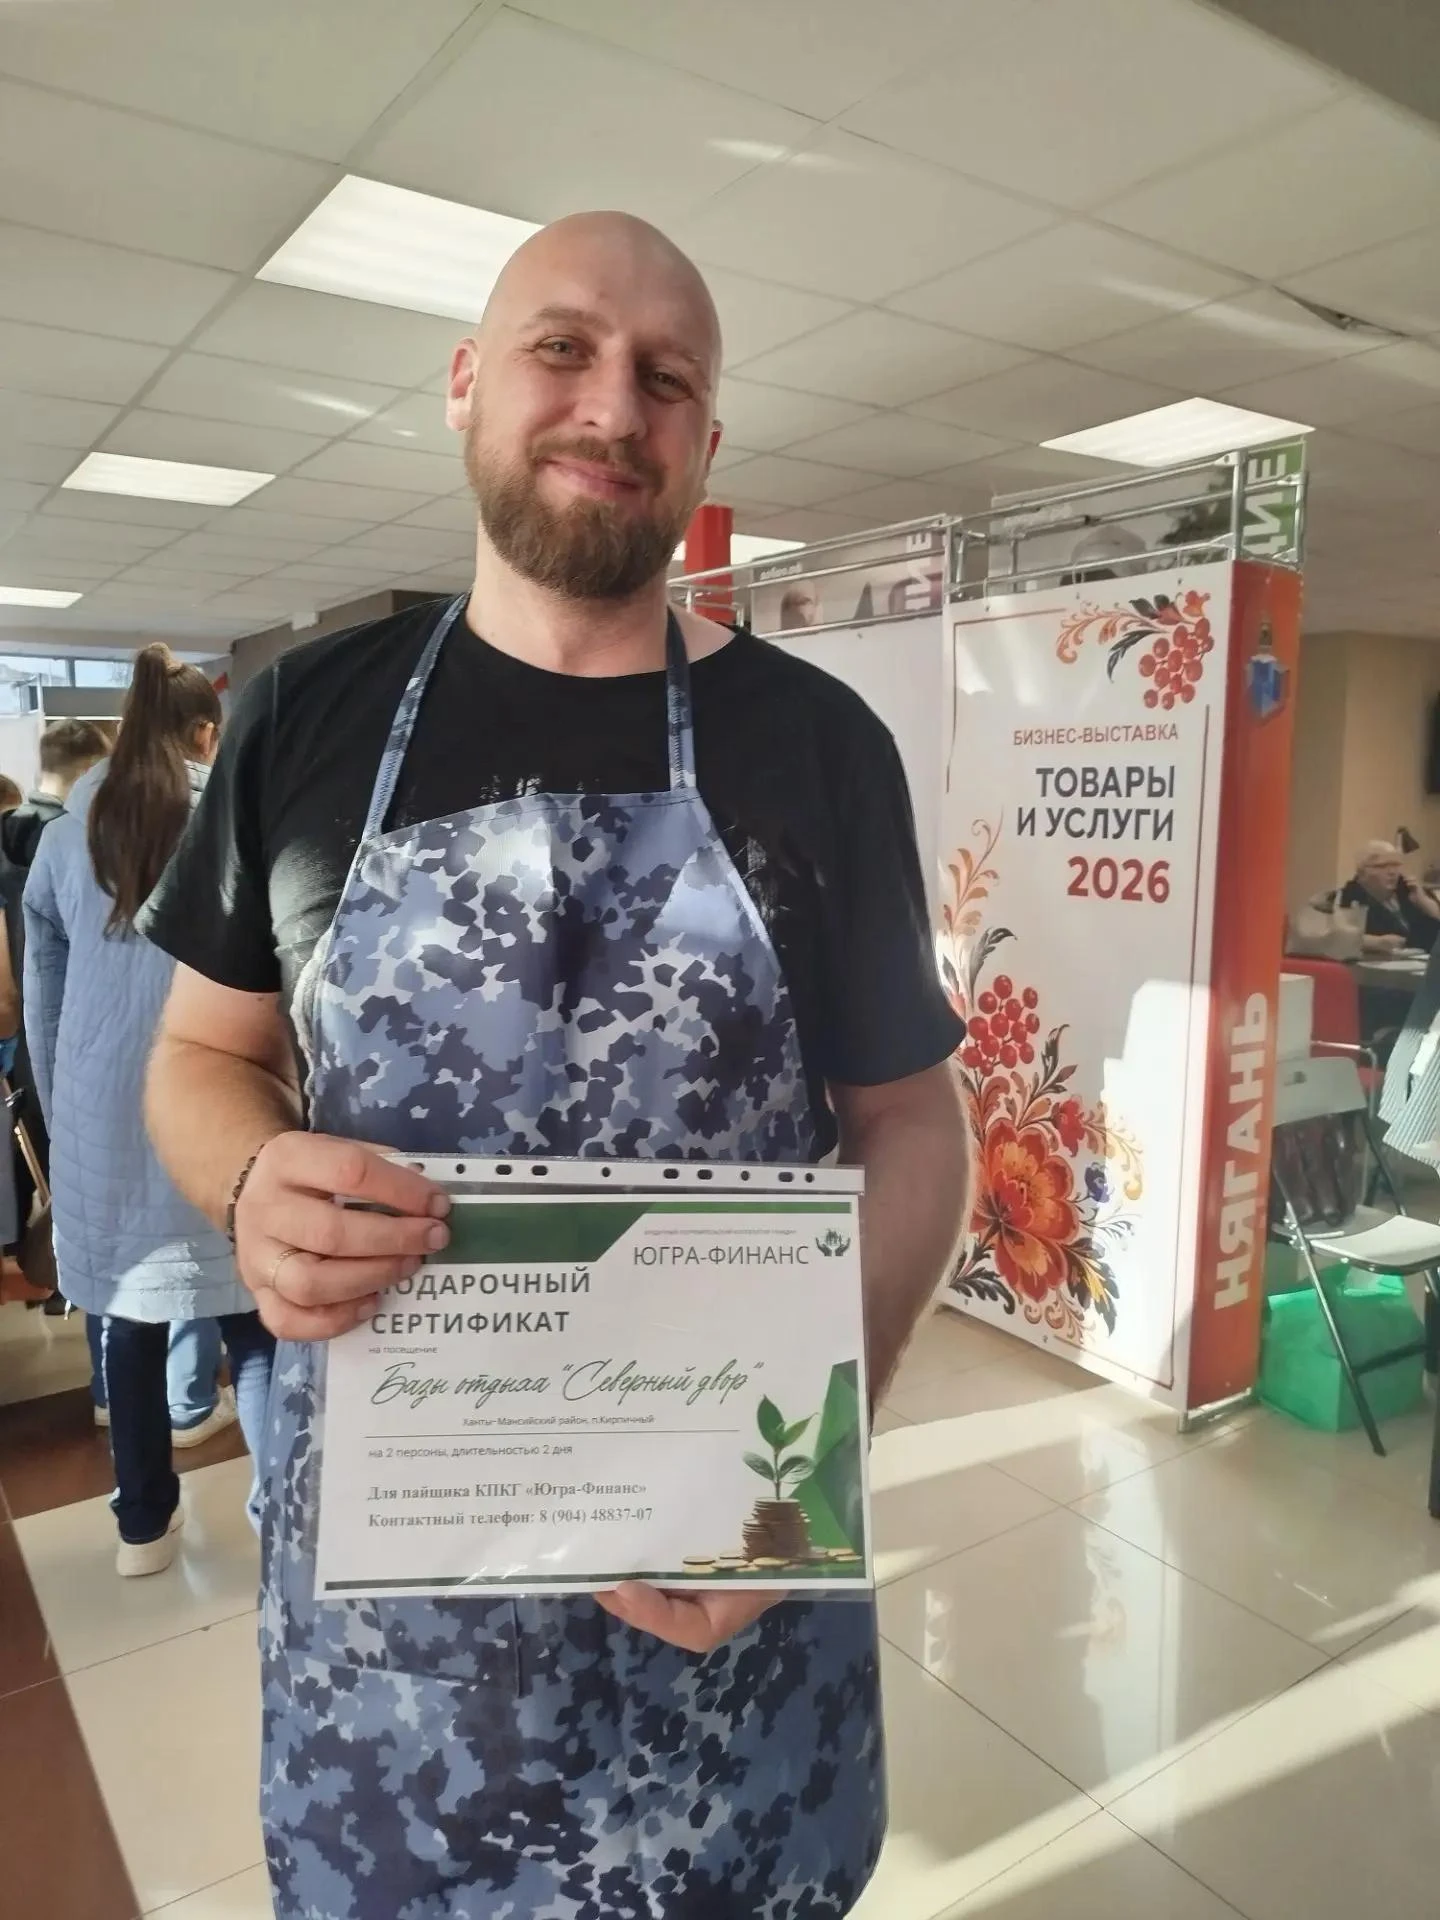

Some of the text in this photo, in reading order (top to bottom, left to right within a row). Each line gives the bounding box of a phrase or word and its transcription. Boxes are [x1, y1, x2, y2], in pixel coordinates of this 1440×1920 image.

[1013, 723, 1179, 746] БИЗНЕС-ВЫСТАВКА
[1035, 765, 1175, 798] ТОВАРЫ
[1017, 807, 1174, 841] И УСЛУГИ
[1067, 856, 1170, 903] 2026
[1213, 992, 1268, 1310] НЯГАНЬ
[633, 1245, 810, 1266] ЮГРА-ФИНАНС
[383, 1266, 591, 1300] ОДАРОЧНЫЙ
[371, 1311, 570, 1334] СЕРТИФИКАТ
[384, 1346, 438, 1354] посещение
[371, 1361, 449, 1409] Базы
[454, 1374, 551, 1409] отдыха
[462, 1416, 556, 1427] Ханты-Мансийский
[368, 1449, 383, 1458] на
[387, 1448, 393, 1457] 2
[451, 1445, 539, 1457] длительностью
[543, 1445, 549, 1455] 2
[552, 1446, 573, 1456] дня
[368, 1481, 646, 1501] Для пайщика КПКГ «Югра-Финанс»
[368, 1508, 653, 1528] Контактный телефон: 8 (904) 48837-07
